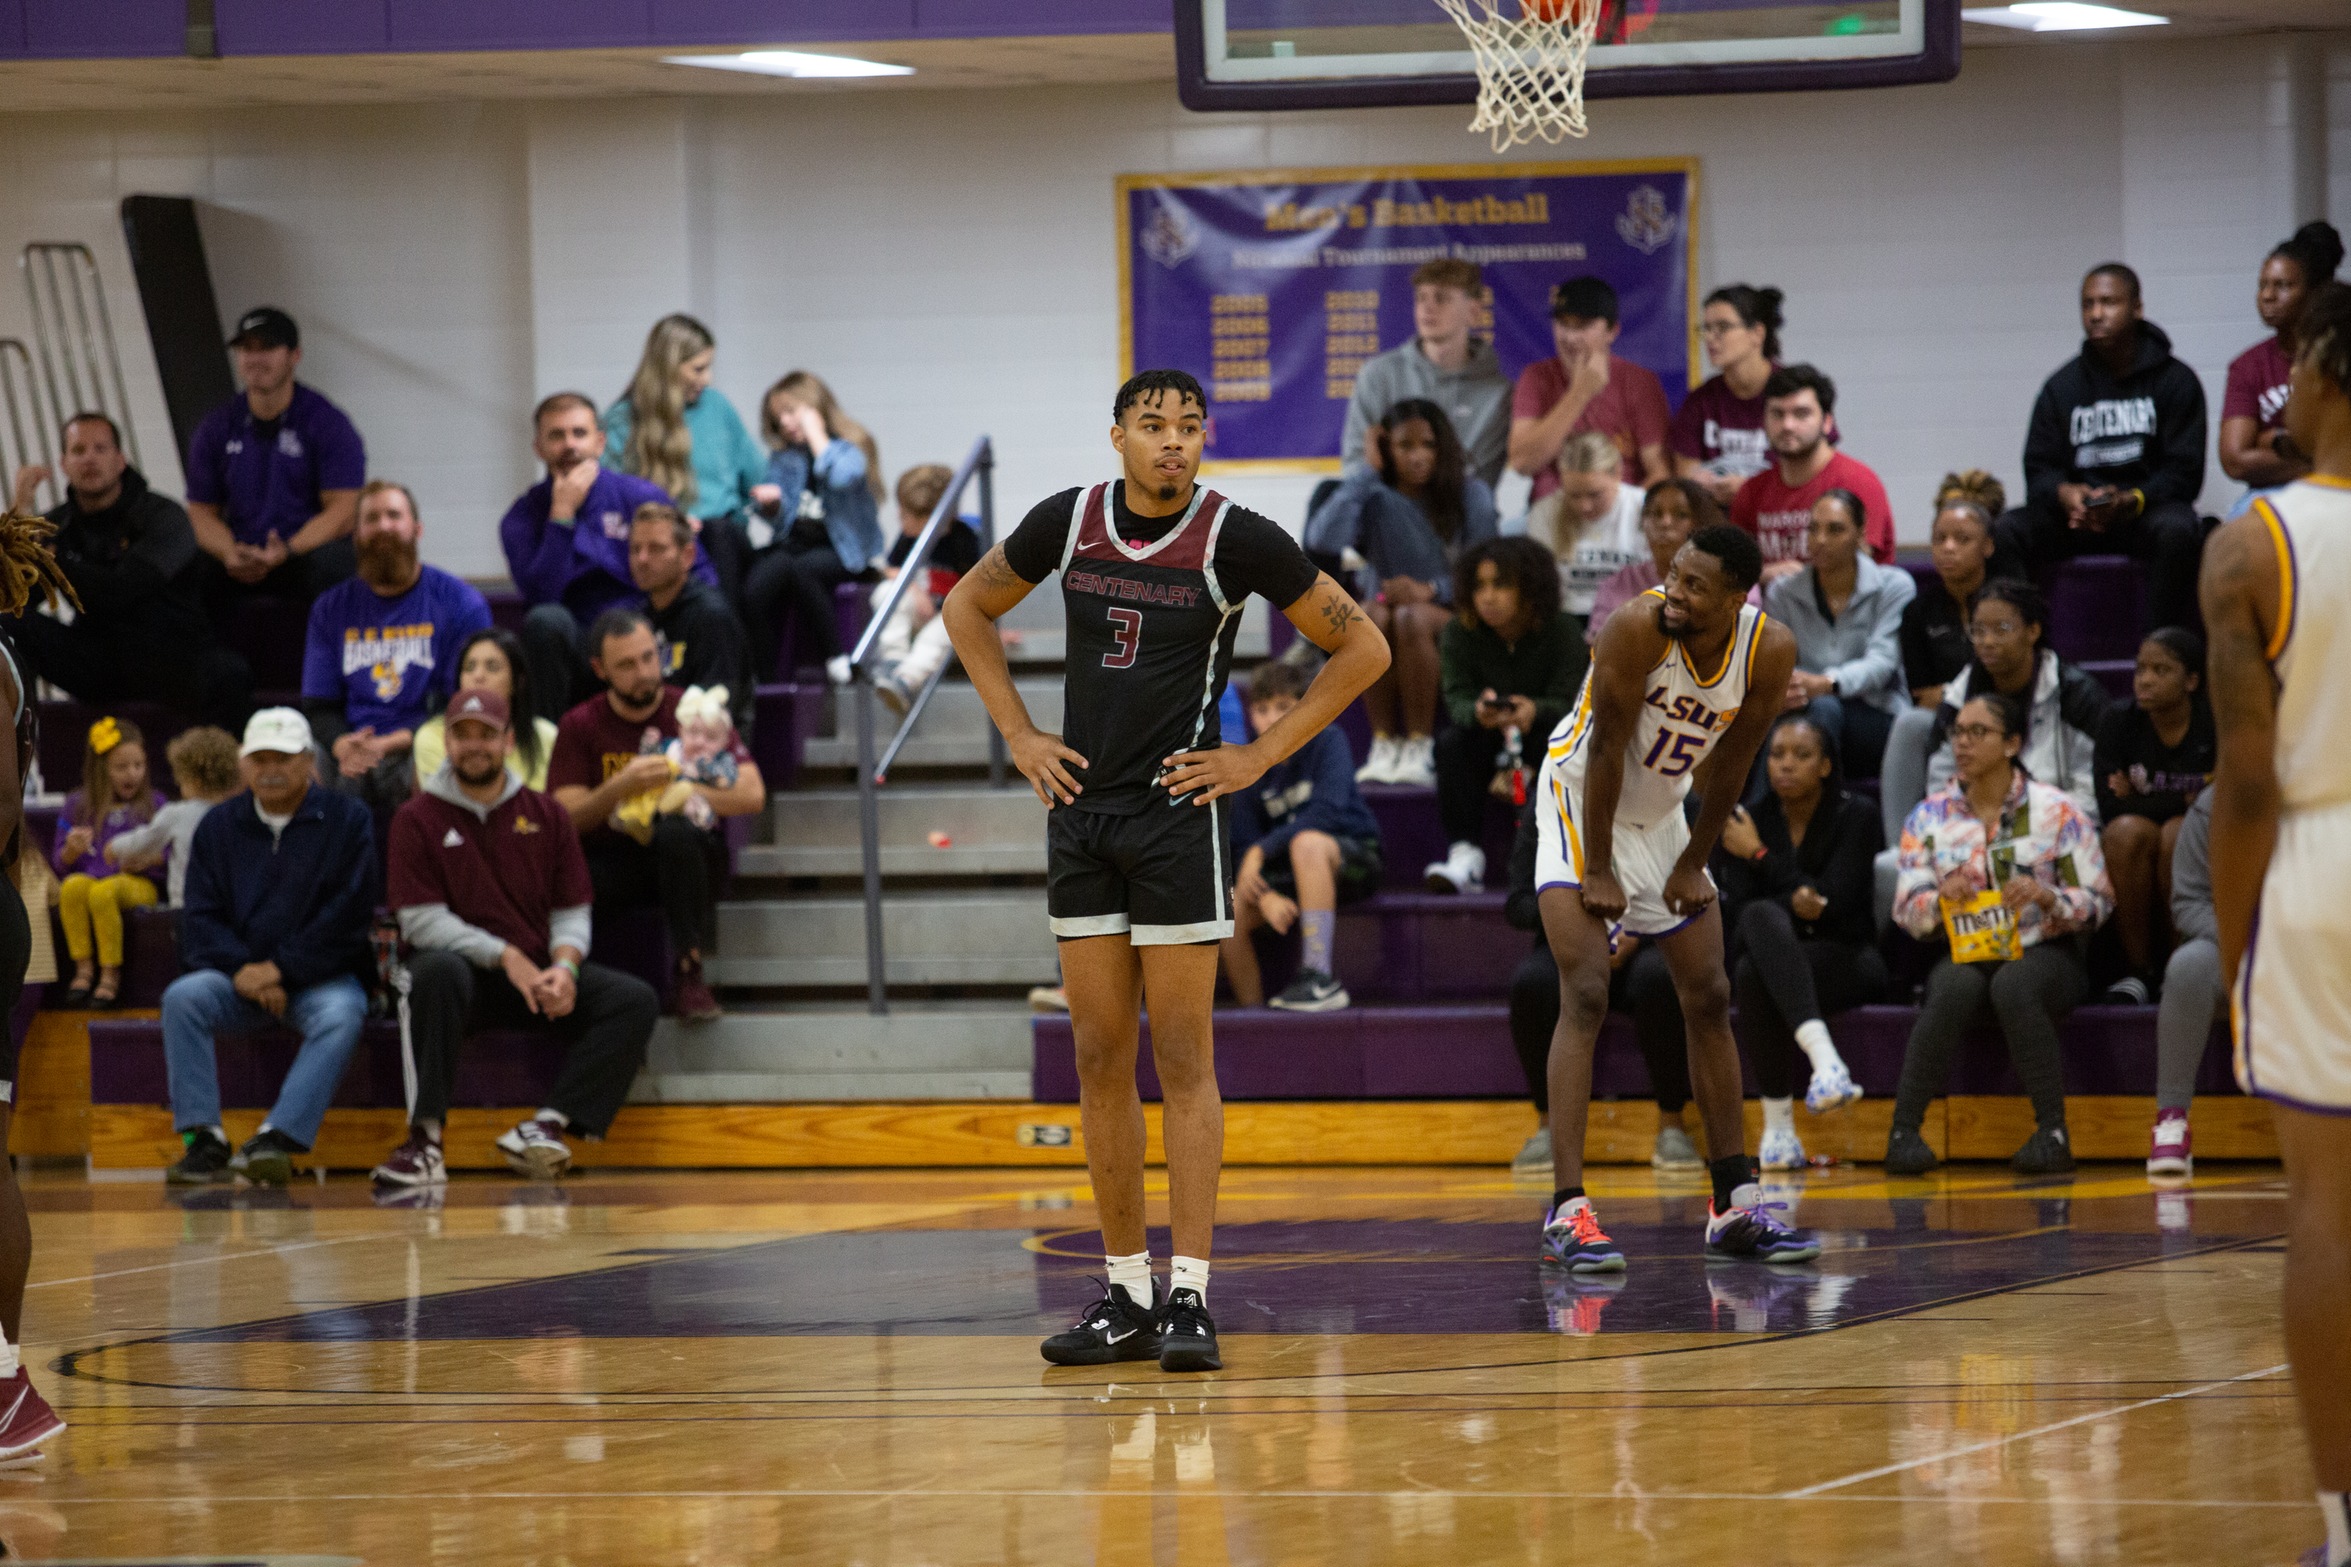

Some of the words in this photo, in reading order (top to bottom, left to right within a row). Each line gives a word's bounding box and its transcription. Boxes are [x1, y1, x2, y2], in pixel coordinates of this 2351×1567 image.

[1373, 193, 1549, 228] Basketball
[1066, 570, 1201, 607] CENTENARY
[1101, 606, 1143, 669] 3
[1643, 726, 1706, 777] 15
